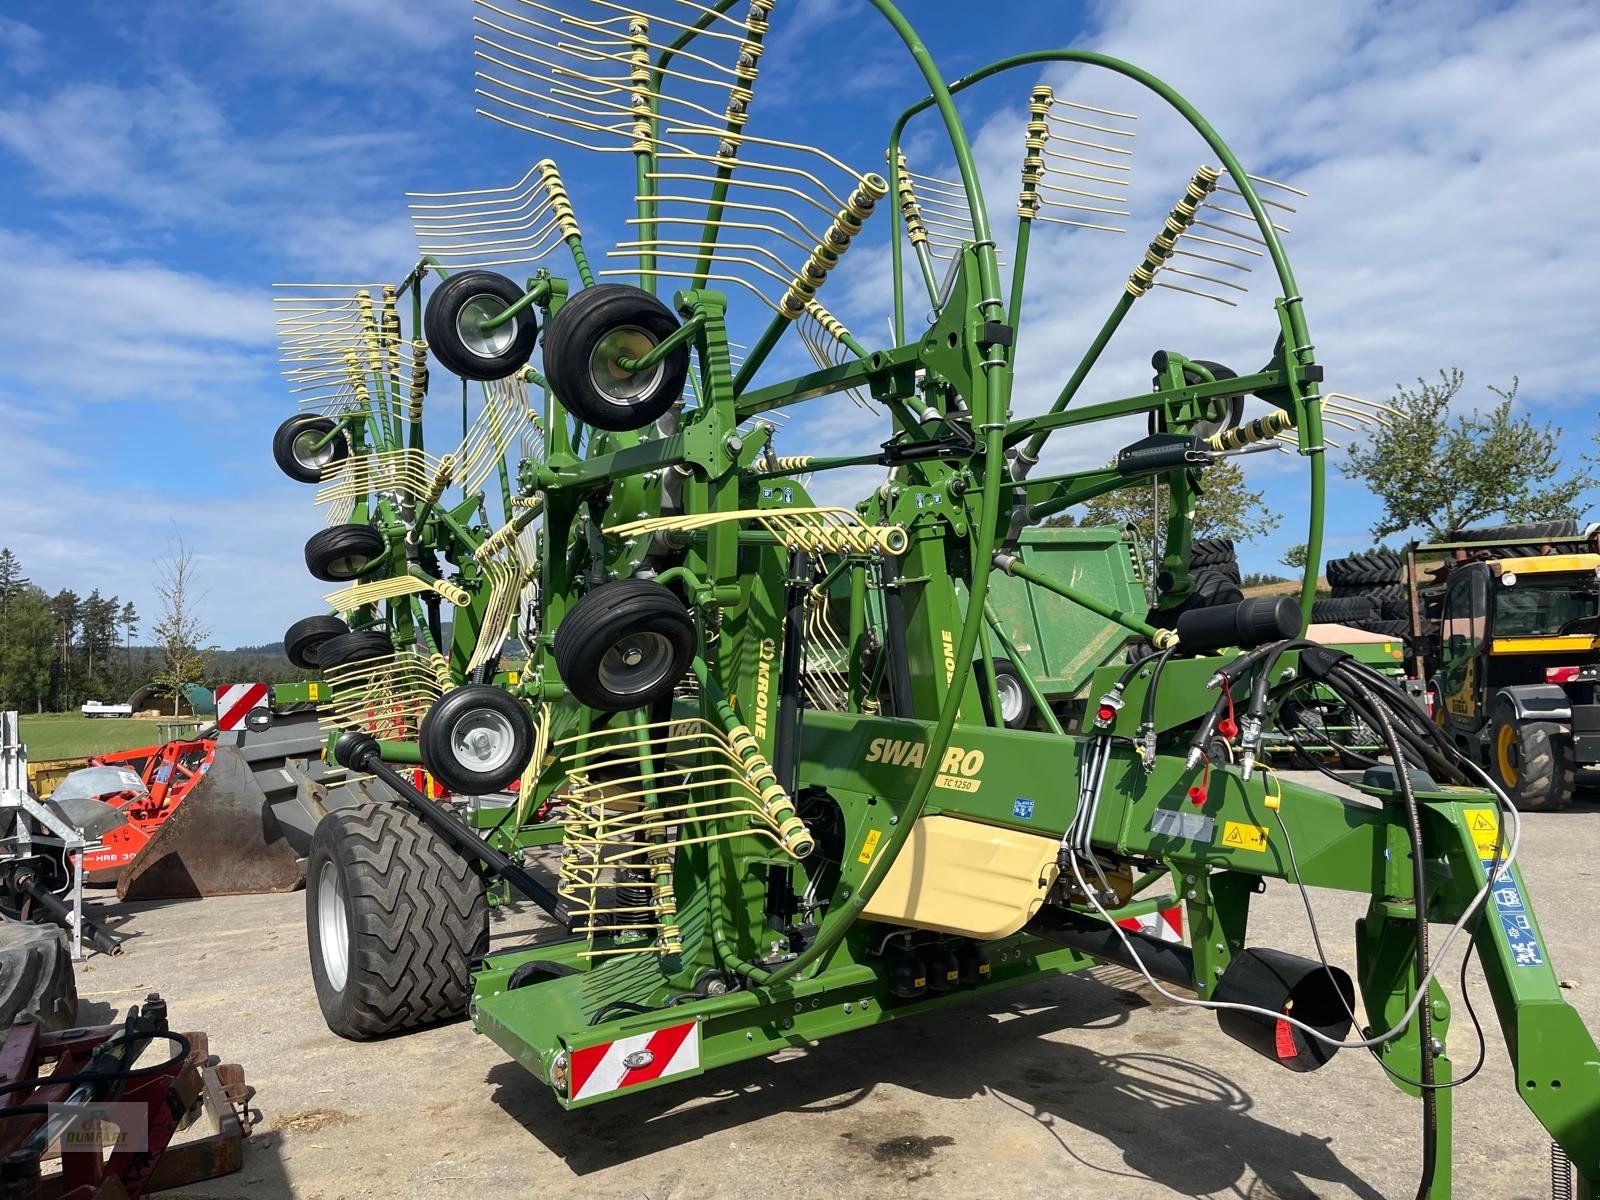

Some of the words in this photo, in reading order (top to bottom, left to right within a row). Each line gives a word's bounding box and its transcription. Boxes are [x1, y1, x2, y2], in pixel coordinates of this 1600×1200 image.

[941, 629, 956, 689] RONE
[755, 660, 771, 740] KRONE
[865, 737, 985, 777] SWARO
[943, 778, 953, 787] TC
[954, 779, 971, 790] 1250
[95, 854, 118, 862] HRB
